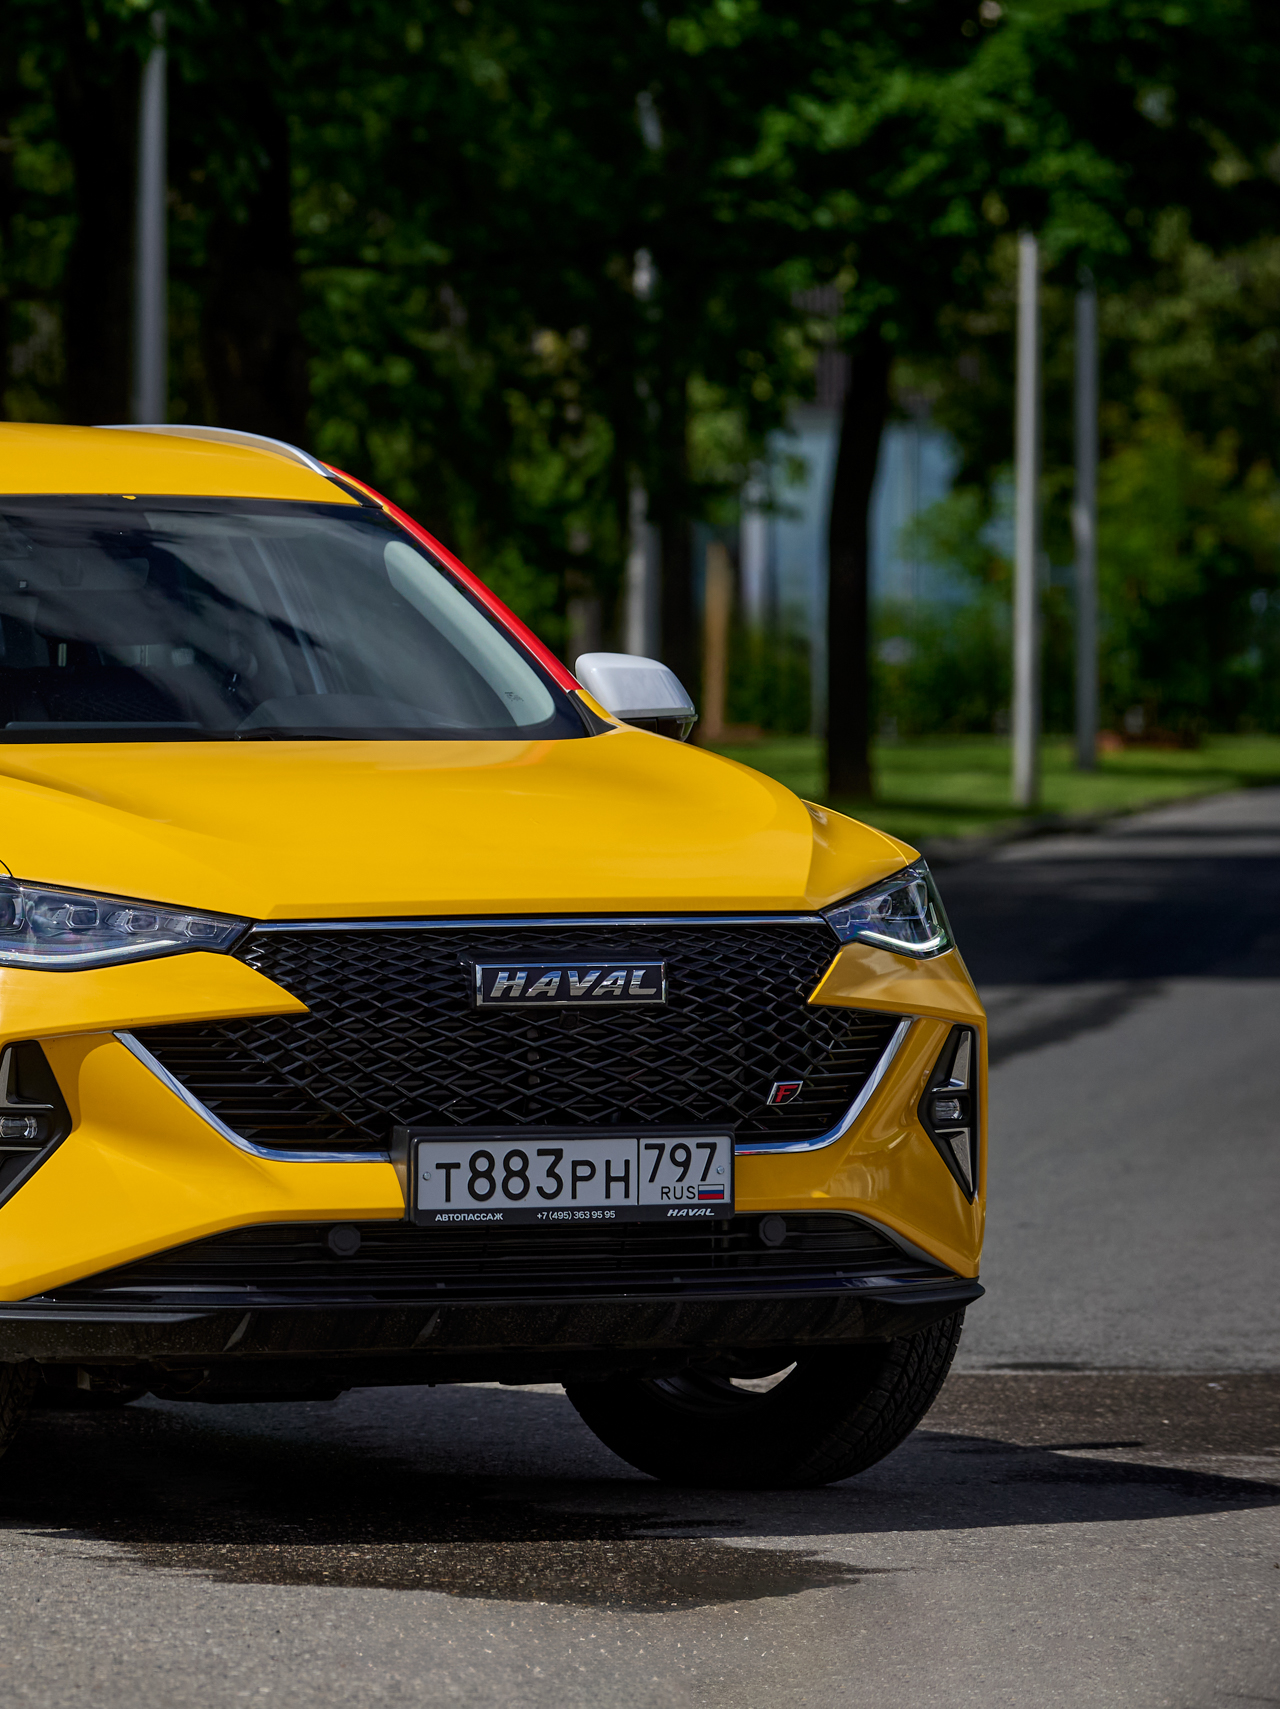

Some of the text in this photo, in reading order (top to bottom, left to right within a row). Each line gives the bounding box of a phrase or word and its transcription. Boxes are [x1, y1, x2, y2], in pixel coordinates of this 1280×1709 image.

[489, 969, 658, 998] HAVAL
[644, 1142, 718, 1183] 797
[661, 1186, 696, 1201] RUS
[435, 1212, 504, 1222] АВТОПАССАЖ
[536, 1210, 616, 1221] +7 (495) 363 95 95
[667, 1208, 715, 1217] HAVAL
